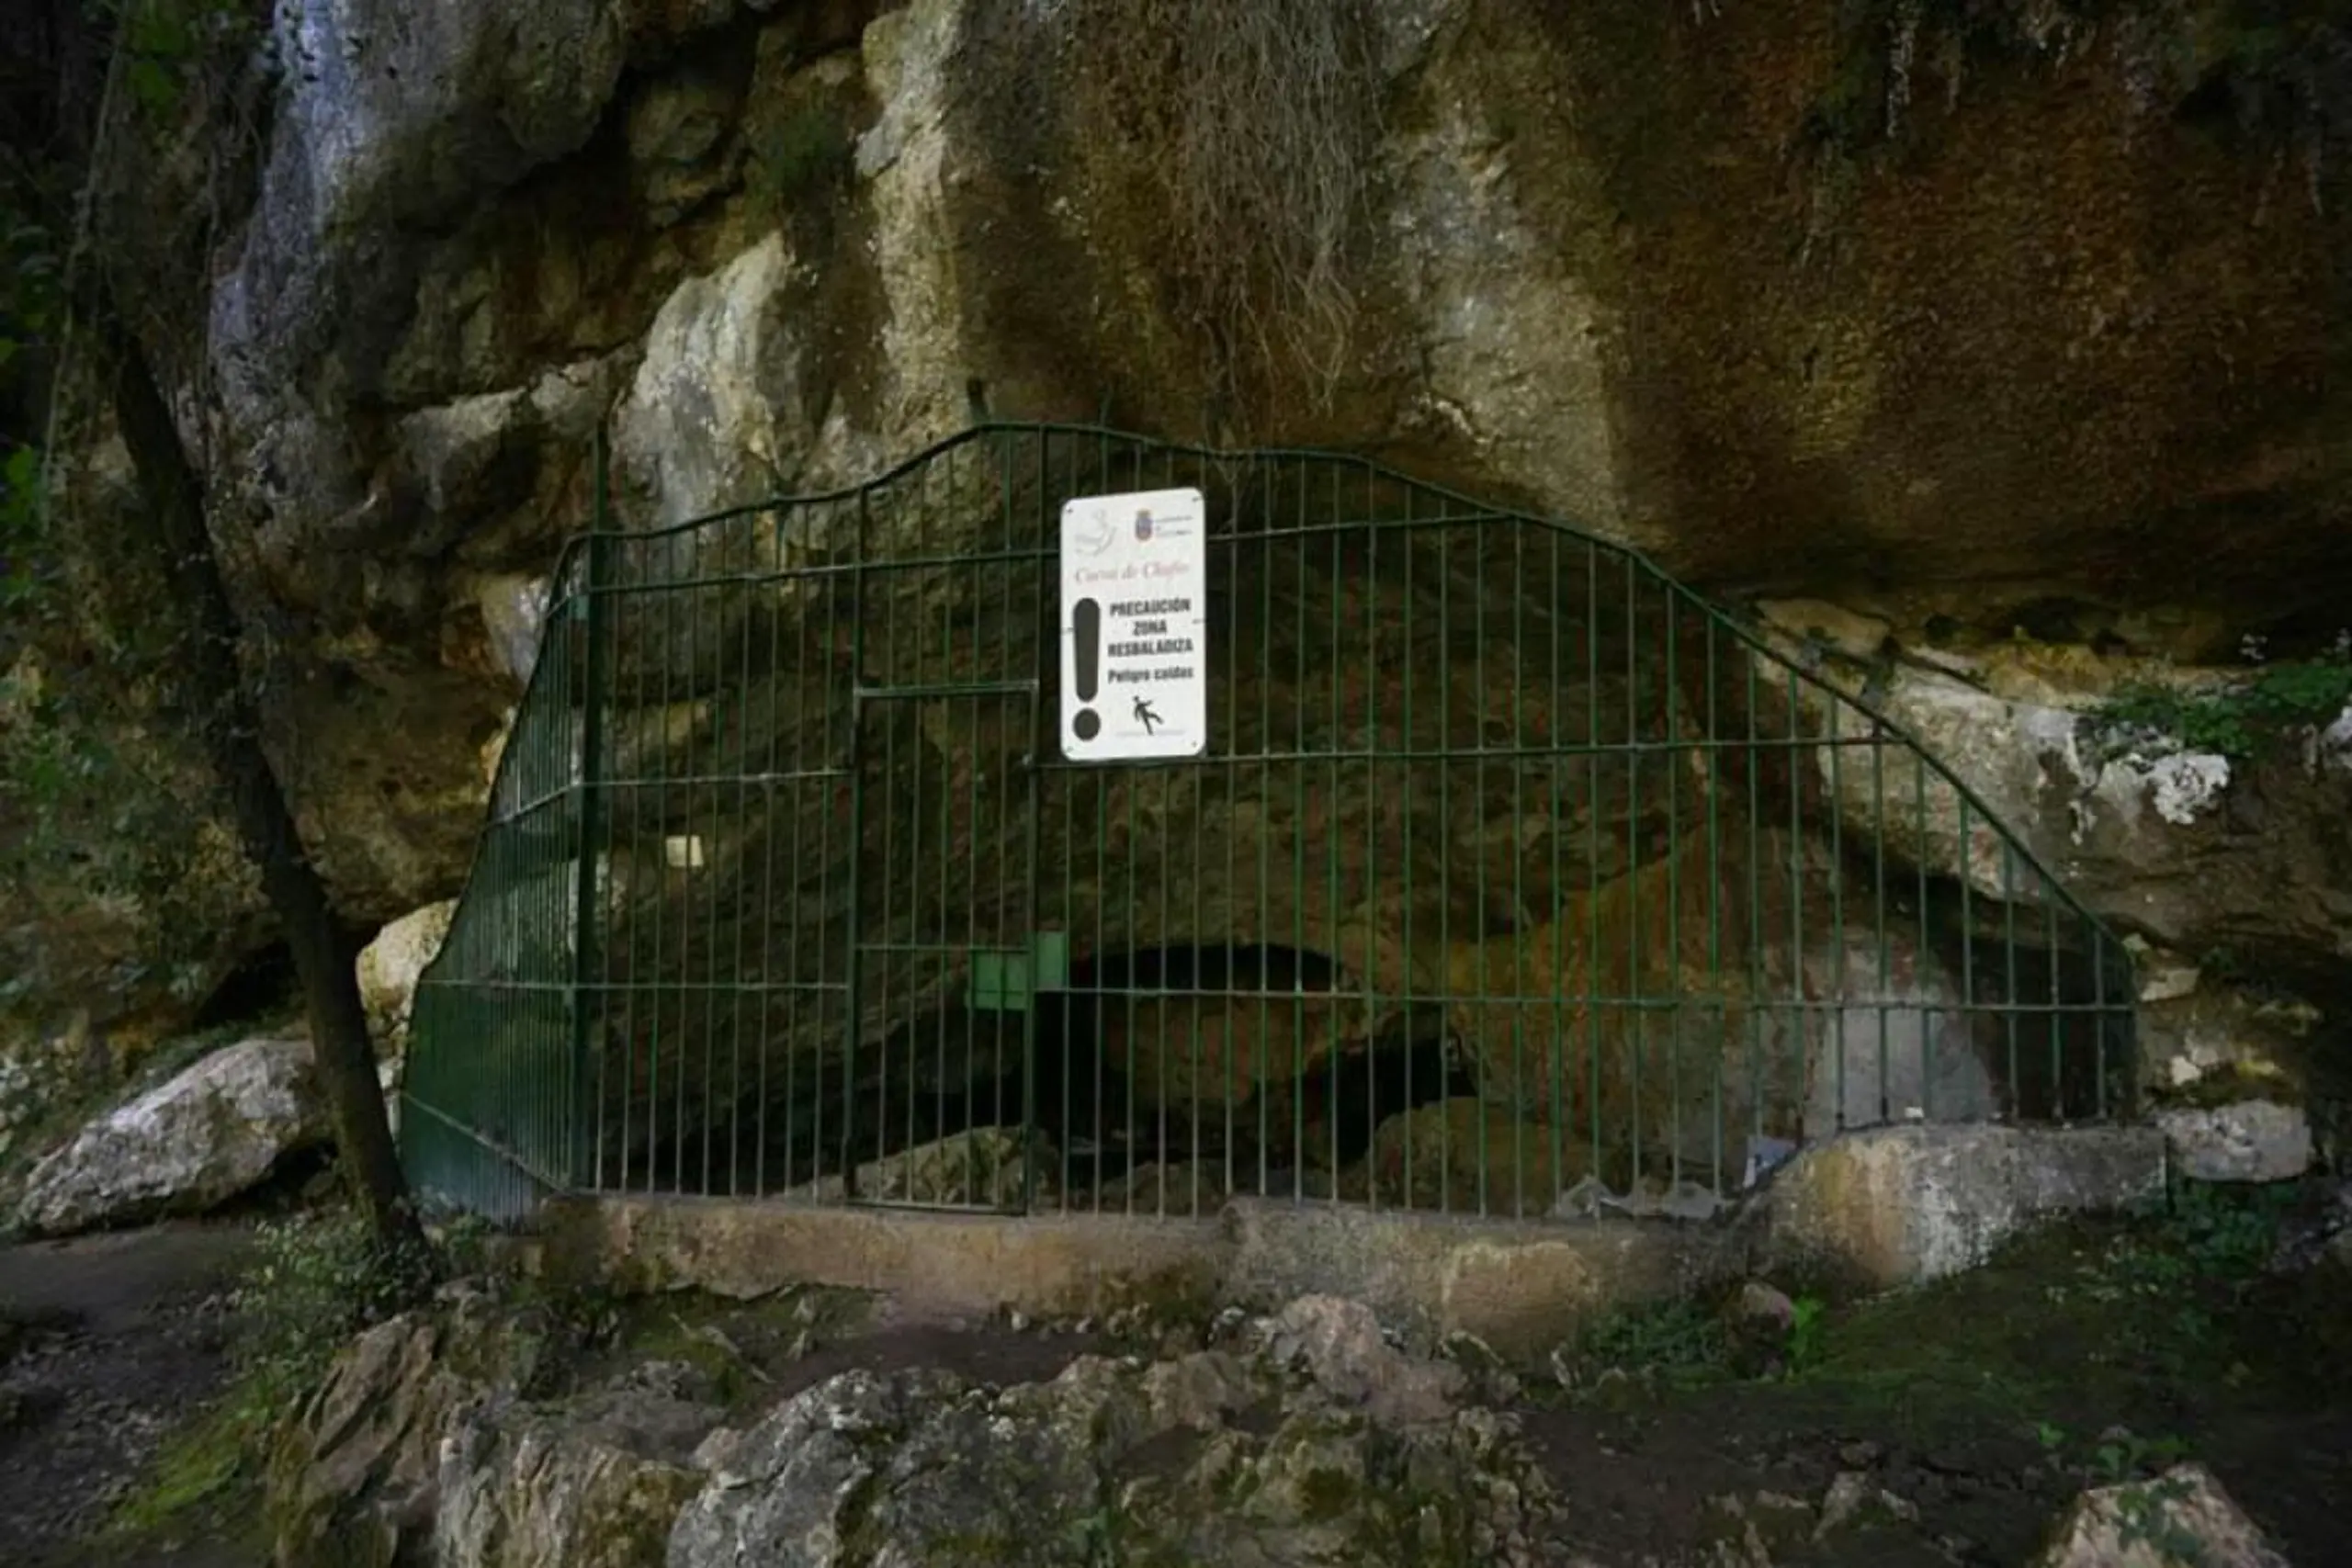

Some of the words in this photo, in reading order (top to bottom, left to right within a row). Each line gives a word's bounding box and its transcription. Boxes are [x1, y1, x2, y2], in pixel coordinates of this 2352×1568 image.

[1133, 619, 1167, 636] ZONA
[1108, 638, 1193, 657] RESBALADIZA
[1108, 669, 1150, 683] Peligro
